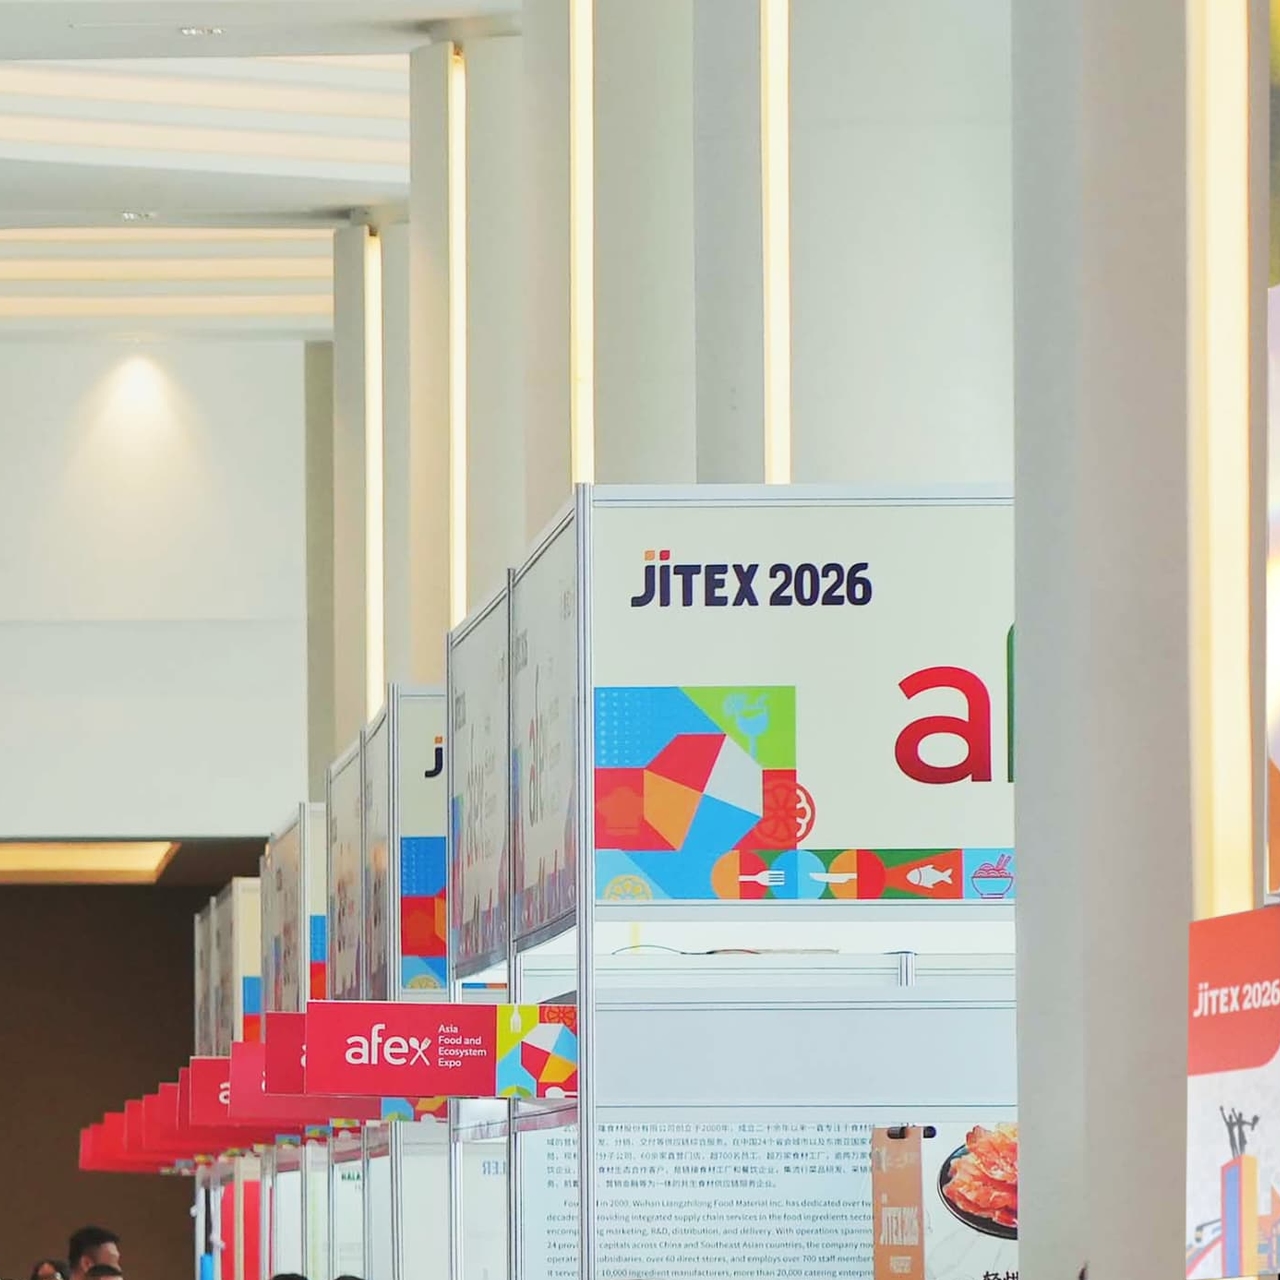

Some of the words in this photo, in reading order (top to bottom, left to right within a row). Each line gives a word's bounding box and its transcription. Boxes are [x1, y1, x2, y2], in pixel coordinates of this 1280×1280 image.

[768, 561, 873, 607] 2026
[1241, 978, 1280, 1010] 2026
[344, 1023, 431, 1066] afex
[437, 1024, 458, 1034] Asia
[437, 1035, 462, 1045] Food
[464, 1035, 482, 1045] and
[437, 1046, 487, 1058] Ecosystem
[437, 1058, 462, 1069] Expo
[341, 1171, 361, 1181] HALA
[714, 1199, 735, 1208] Food
[736, 1199, 768, 1208] Material
[786, 1199, 800, 1208] has
[801, 1199, 841, 1208] dedicated
[597, 1213, 630, 1224] roviding
[631, 1213, 673, 1224] integrated
[674, 1213, 701, 1224] supply
[702, 1213, 725, 1222] chain
[726, 1213, 758, 1222] services
[769, 1213, 783, 1222] the
[784, 1213, 802, 1222] food
[803, 1213, 848, 1224] ingredients
[723, 1227, 738, 1236] and
[775, 1227, 794, 1236] With
[796, 1227, 838, 1238] operations
[599, 1241, 630, 1252] capitals
[659, 1241, 682, 1250] China
[684, 1241, 699, 1250] and
[700, 1241, 740, 1250] Southeast
[743, 1241, 764, 1250] Asian
[806, 1241, 820, 1250] the
[821, 1243, 859, 1252] company
[677, 1254, 700, 1263] direct
[730, 1254, 746, 1263] and
[747, 1254, 782, 1265] employs
[803, 1254, 817, 1263] 700
[818, 1254, 836, 1263] staff
[602, 1268, 627, 1279] 10,000
[629, 1268, 670, 1279] ingredient
[756, 1268, 775, 1277] than
[777, 1268, 803, 1279] 20,000
[804, 1268, 837, 1279] catering
